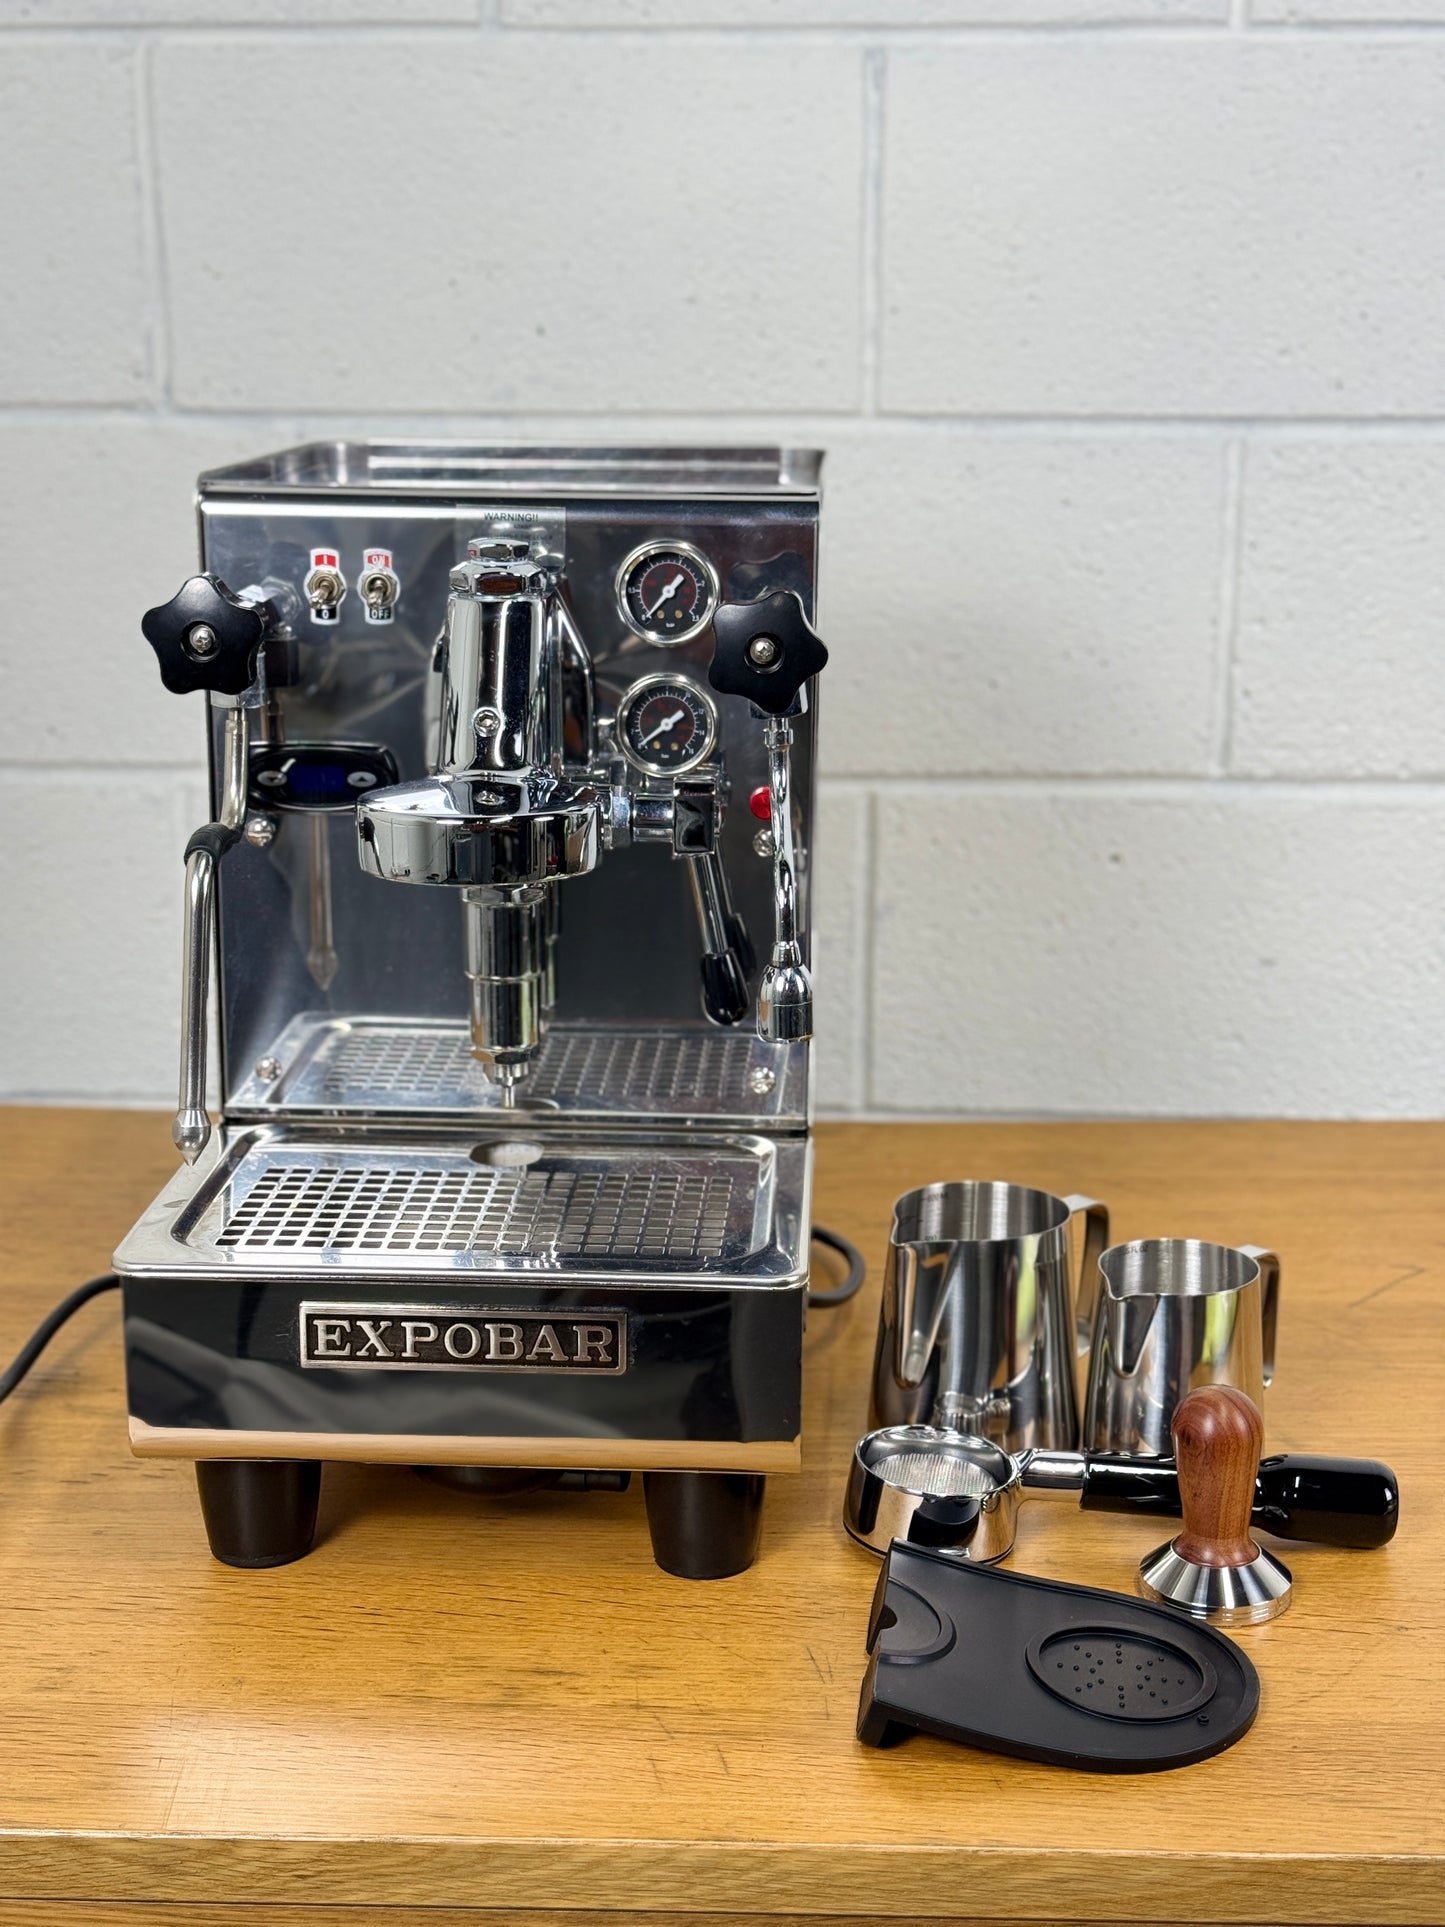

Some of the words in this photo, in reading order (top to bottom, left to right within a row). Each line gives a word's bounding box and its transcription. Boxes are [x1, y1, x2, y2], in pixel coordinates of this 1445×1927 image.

[484, 512, 539, 522] WARNING!!
[371, 555, 386, 566] ON
[371, 609, 390, 620] OFF
[312, 1319, 613, 1363] EXPOBAR
